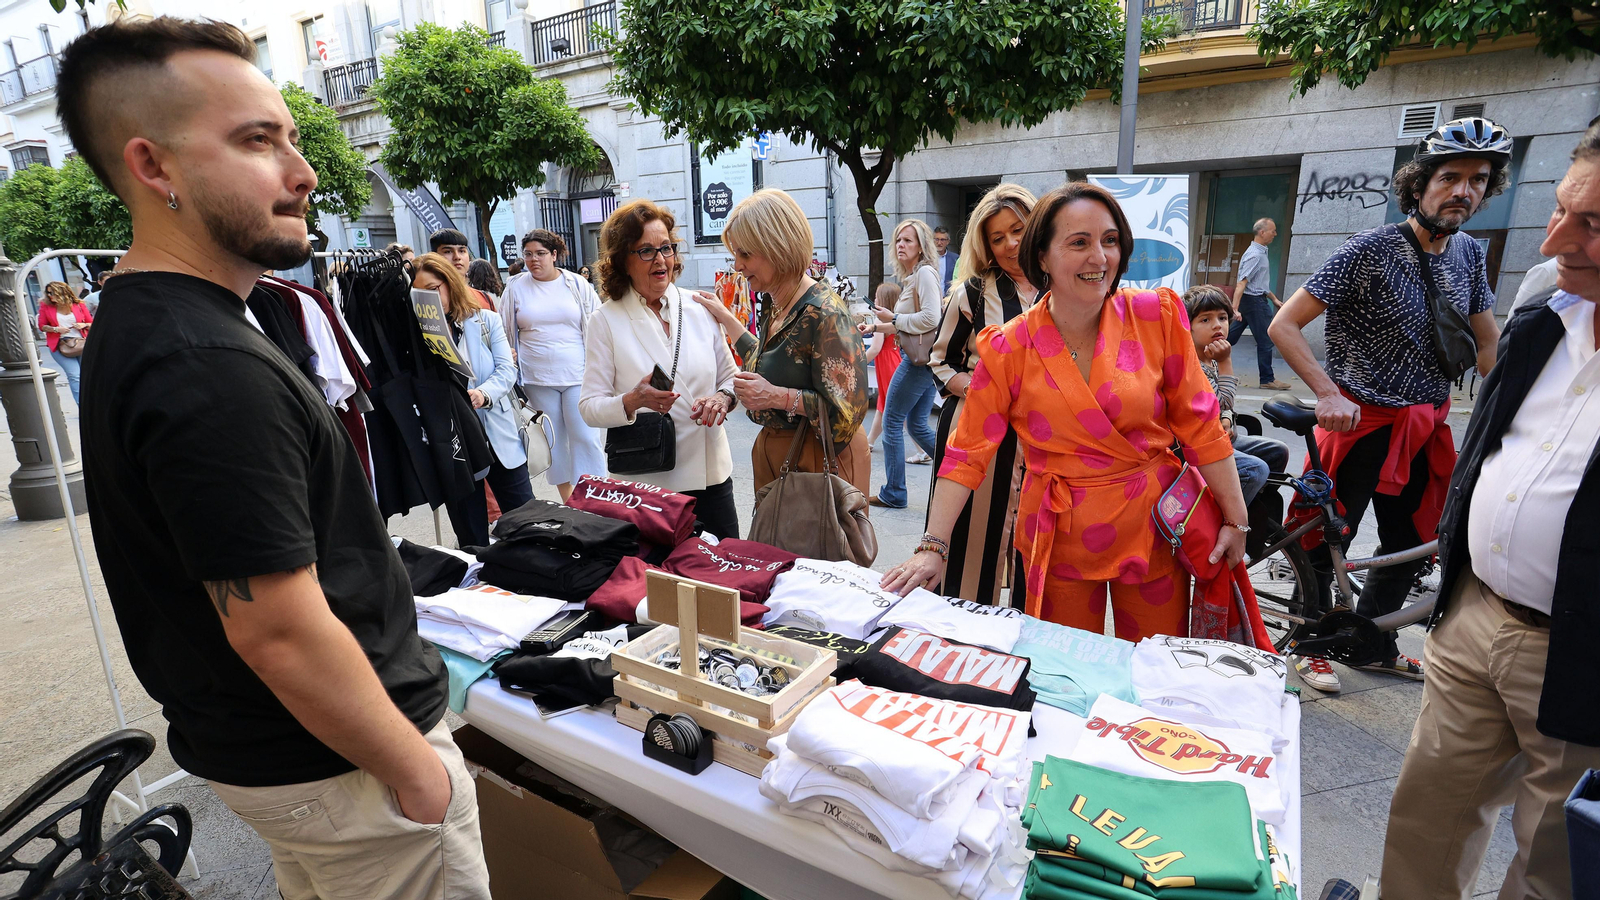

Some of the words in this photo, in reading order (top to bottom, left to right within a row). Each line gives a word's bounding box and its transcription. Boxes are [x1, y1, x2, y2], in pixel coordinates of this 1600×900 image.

[585, 484, 642, 509] CUBATA
[884, 629, 1028, 692] MALAJE
[1085, 716, 1168, 757] Tible
[1160, 727, 1197, 741] COÑO
[1169, 742, 1274, 779] Hard
[823, 801, 842, 820] XXL
